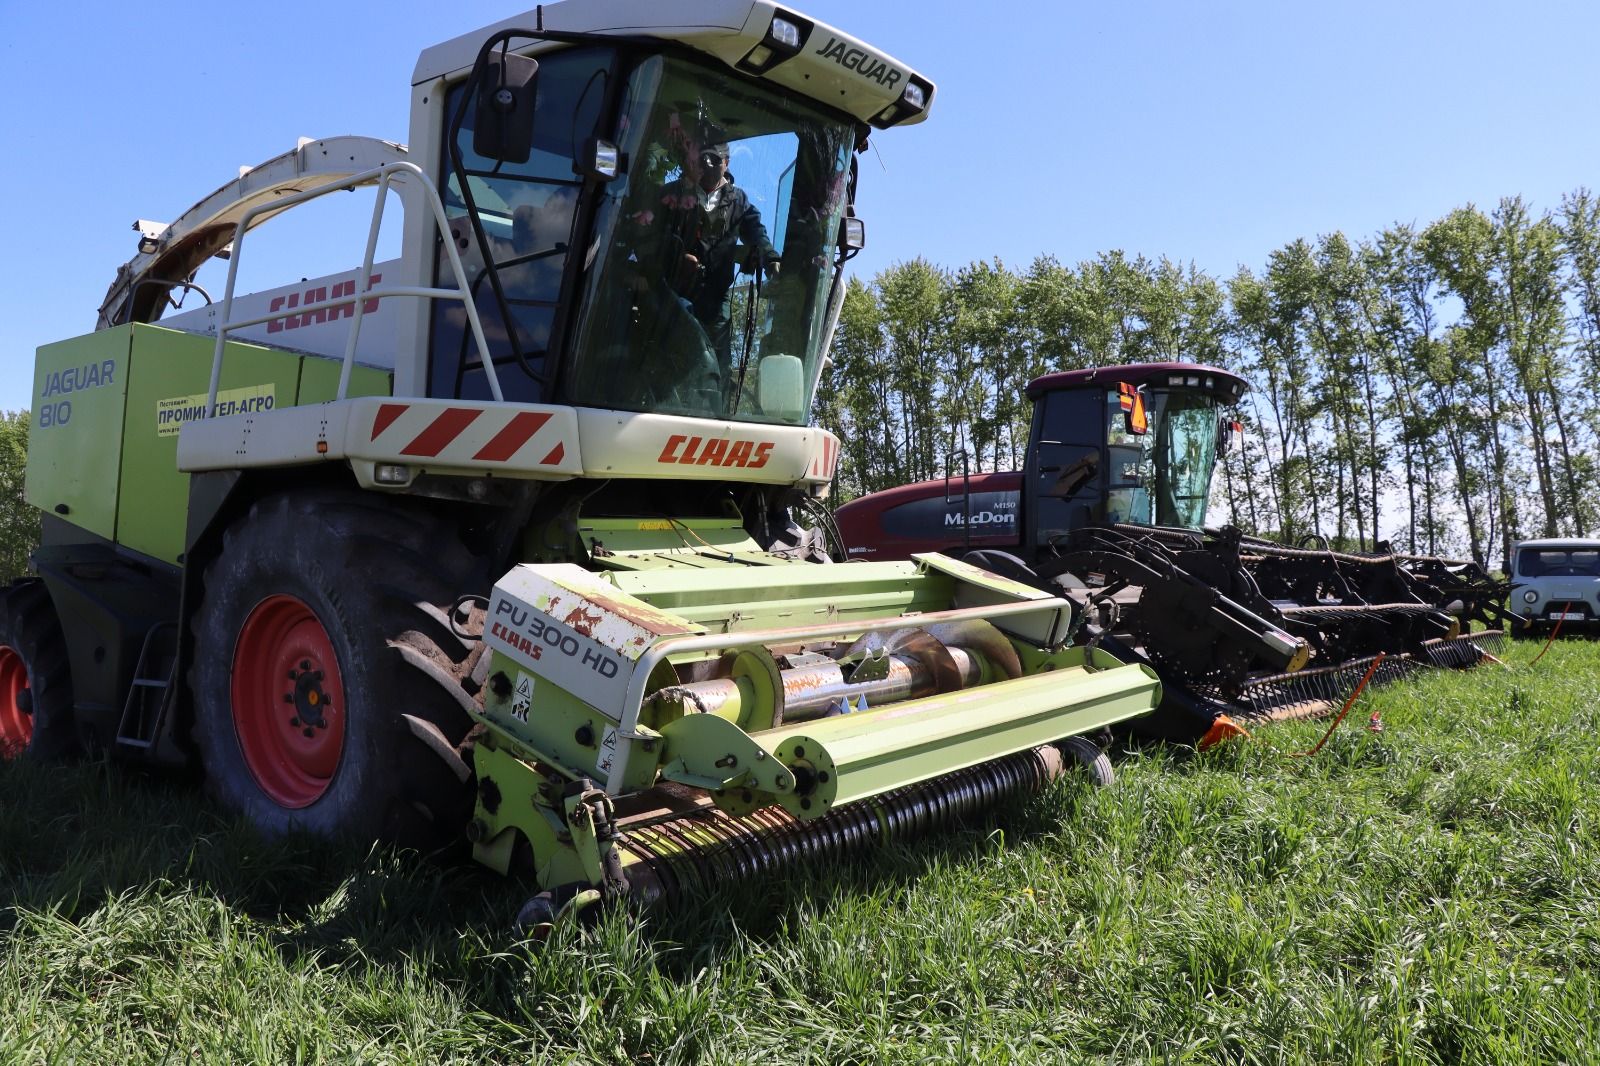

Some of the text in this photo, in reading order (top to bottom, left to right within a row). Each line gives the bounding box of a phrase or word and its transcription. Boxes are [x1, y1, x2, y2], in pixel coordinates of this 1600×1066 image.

[815, 38, 902, 90] JAGUAR
[41, 360, 115, 397] JAGUAR
[657, 434, 775, 468] CLAAS
[491, 622, 543, 661] CLAAS
[495, 599, 619, 679] PU 300 HD
